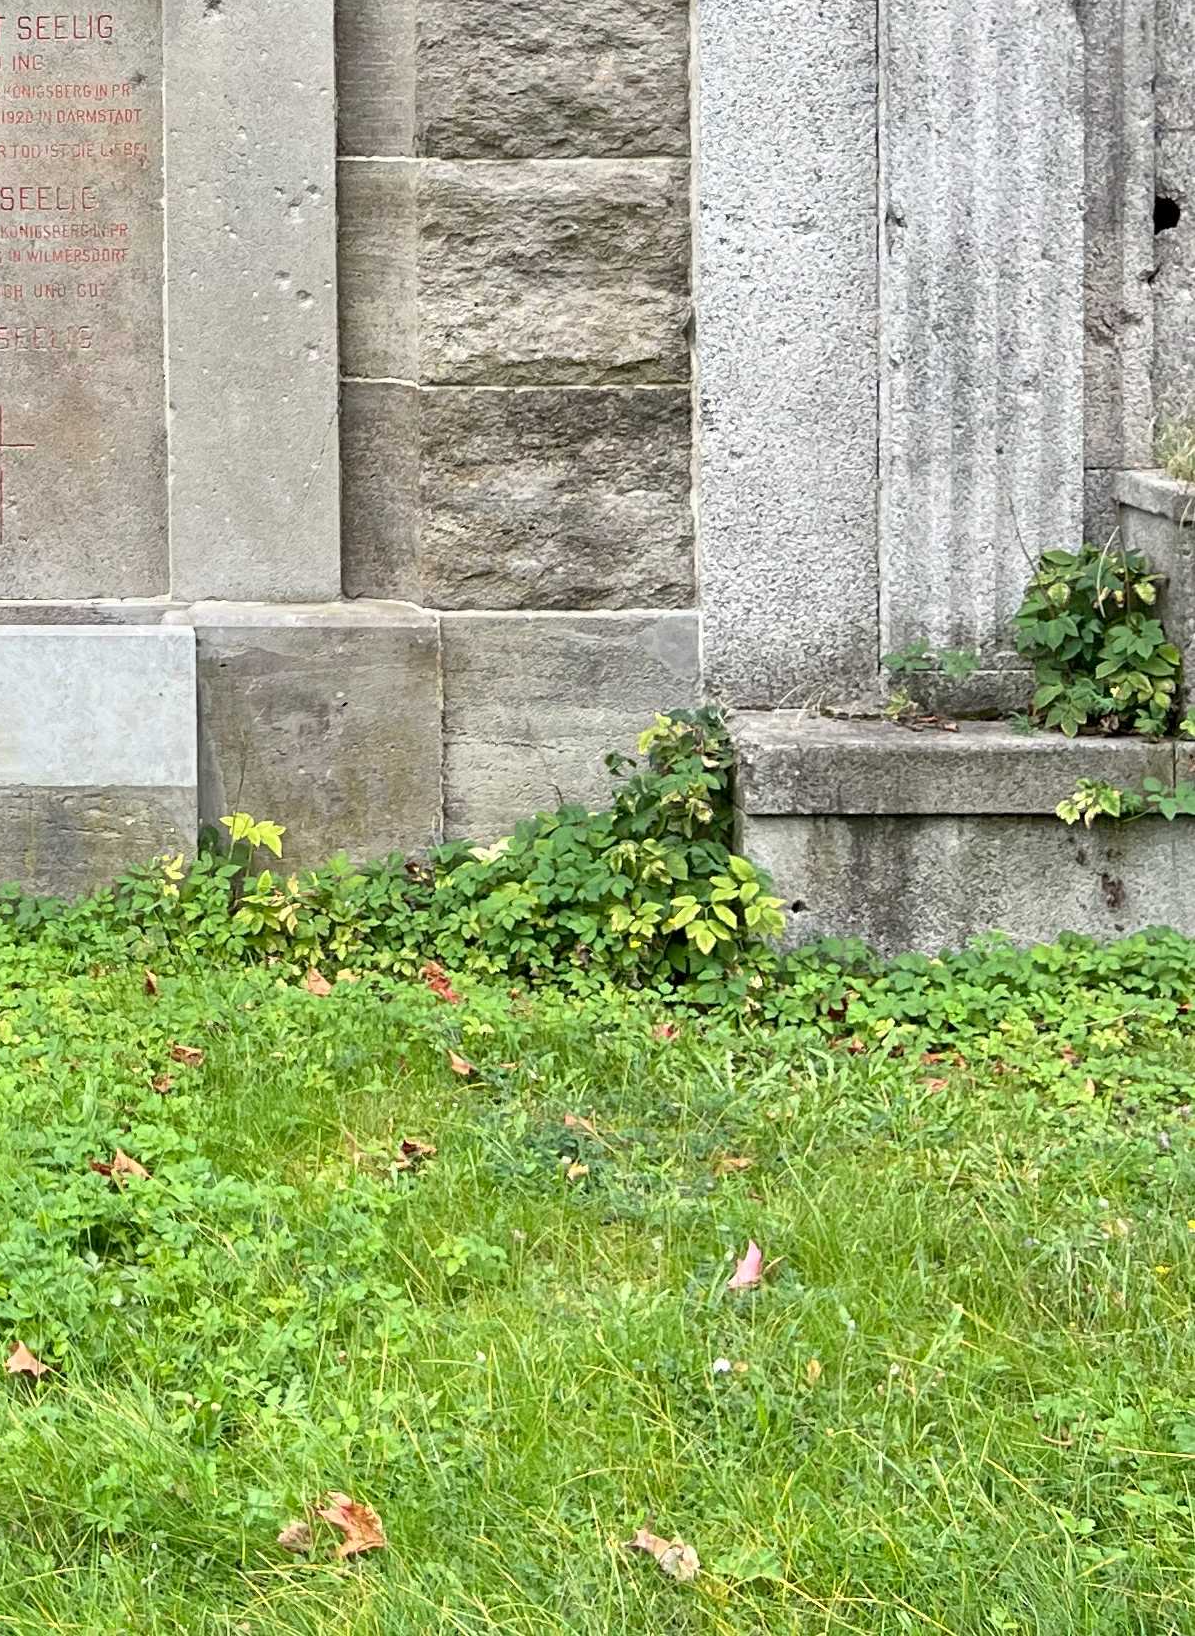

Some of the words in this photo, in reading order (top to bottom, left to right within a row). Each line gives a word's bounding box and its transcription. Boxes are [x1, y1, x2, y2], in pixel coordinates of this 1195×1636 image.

[16, 14, 114, 41] SEELIG
[56, 108, 143, 125] DARMSTADT
[0, 186, 100, 212] SEELIG
[26, 247, 130, 263] WILMERSDORF
